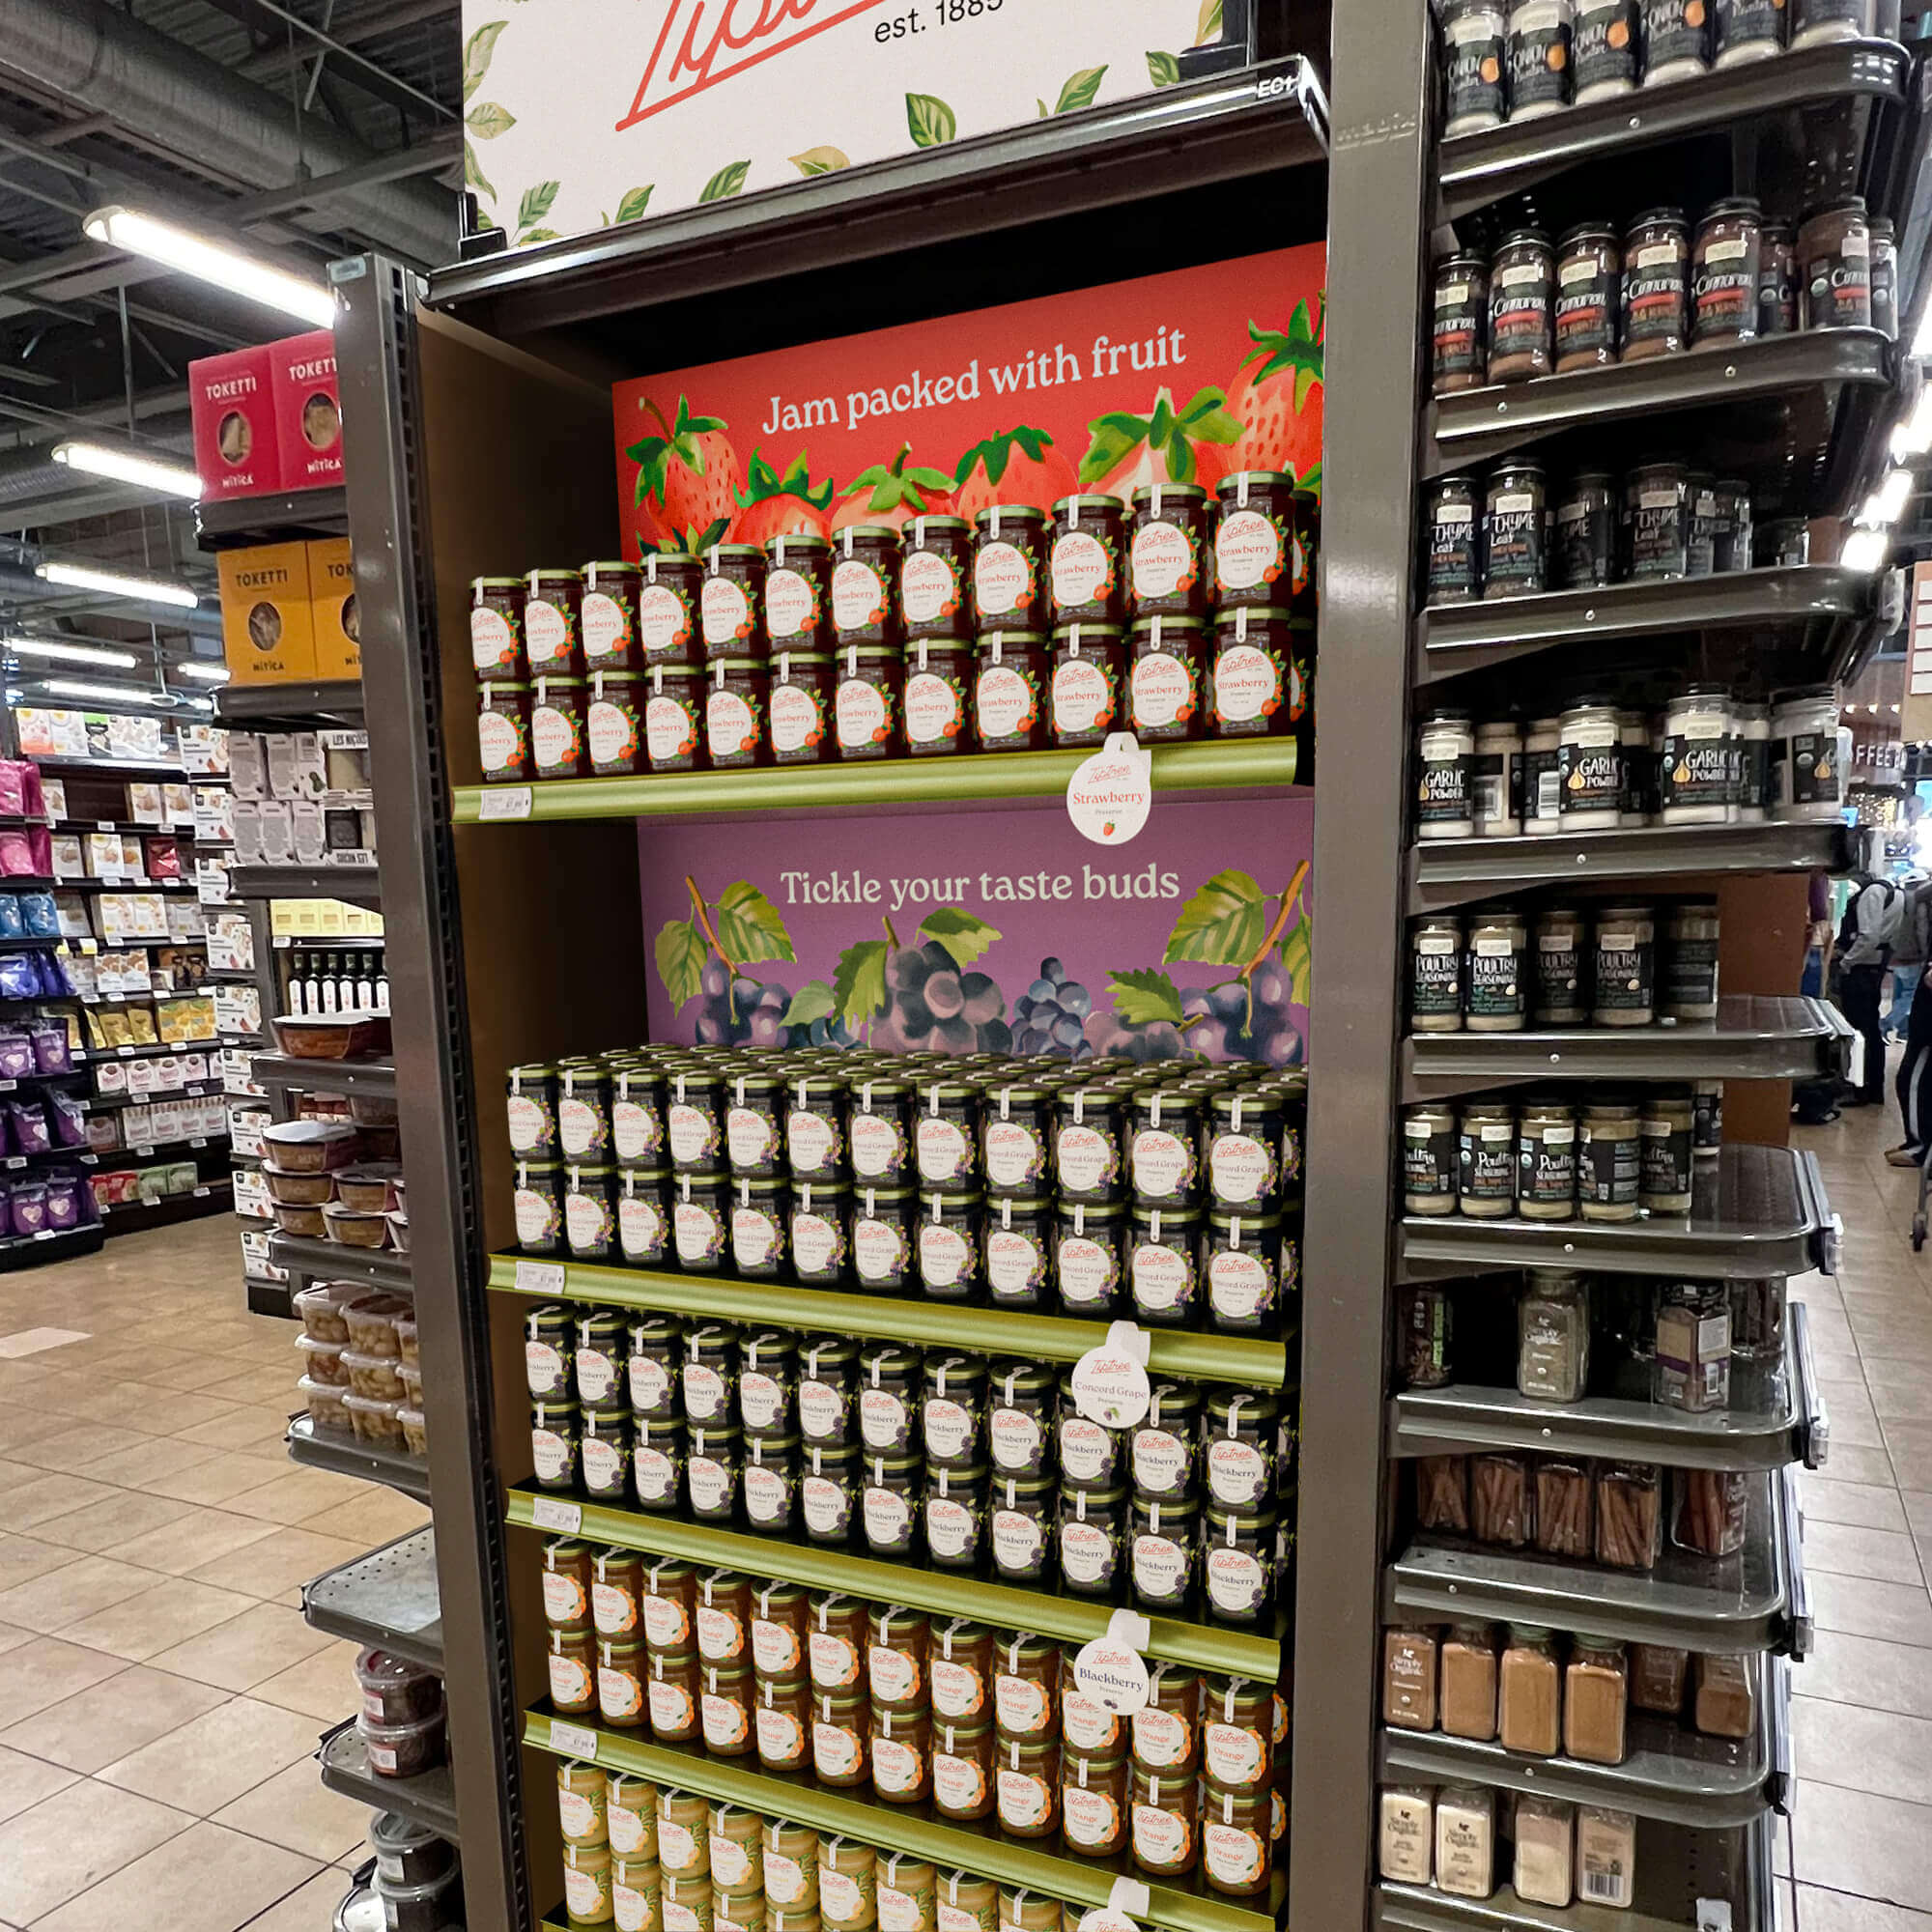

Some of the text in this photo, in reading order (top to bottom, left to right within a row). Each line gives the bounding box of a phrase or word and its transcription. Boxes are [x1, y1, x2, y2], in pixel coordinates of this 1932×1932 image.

[873, 7, 926, 43] est.
[762, 325, 1187, 434] Jam packed with fruit
[206, 376, 257, 400] TOKETTI
[1491, 511, 1536, 533] THYME
[1431, 524, 1474, 542] THYME
[236, 568, 288, 587] TOKETTI
[1073, 790, 1145, 805] Strawberry
[781, 863, 1180, 912] Tickle your taste buds
[1091, 1360, 1132, 1375] Tiptree
[1074, 1381, 1147, 1400] Concord Grape
[1092, 1650, 1132, 1665] Tiptree
[1079, 1667, 1144, 1692] Blackberry
[1068, 1713, 1098, 1726] Orange
[1140, 1729, 1171, 1744] Orange
[1214, 1746, 1245, 1761] Orange
[1069, 1809, 1098, 1824] Orange
[1140, 1828, 1170, 1842] Orange
[1213, 1846, 1244, 1861] Orange
